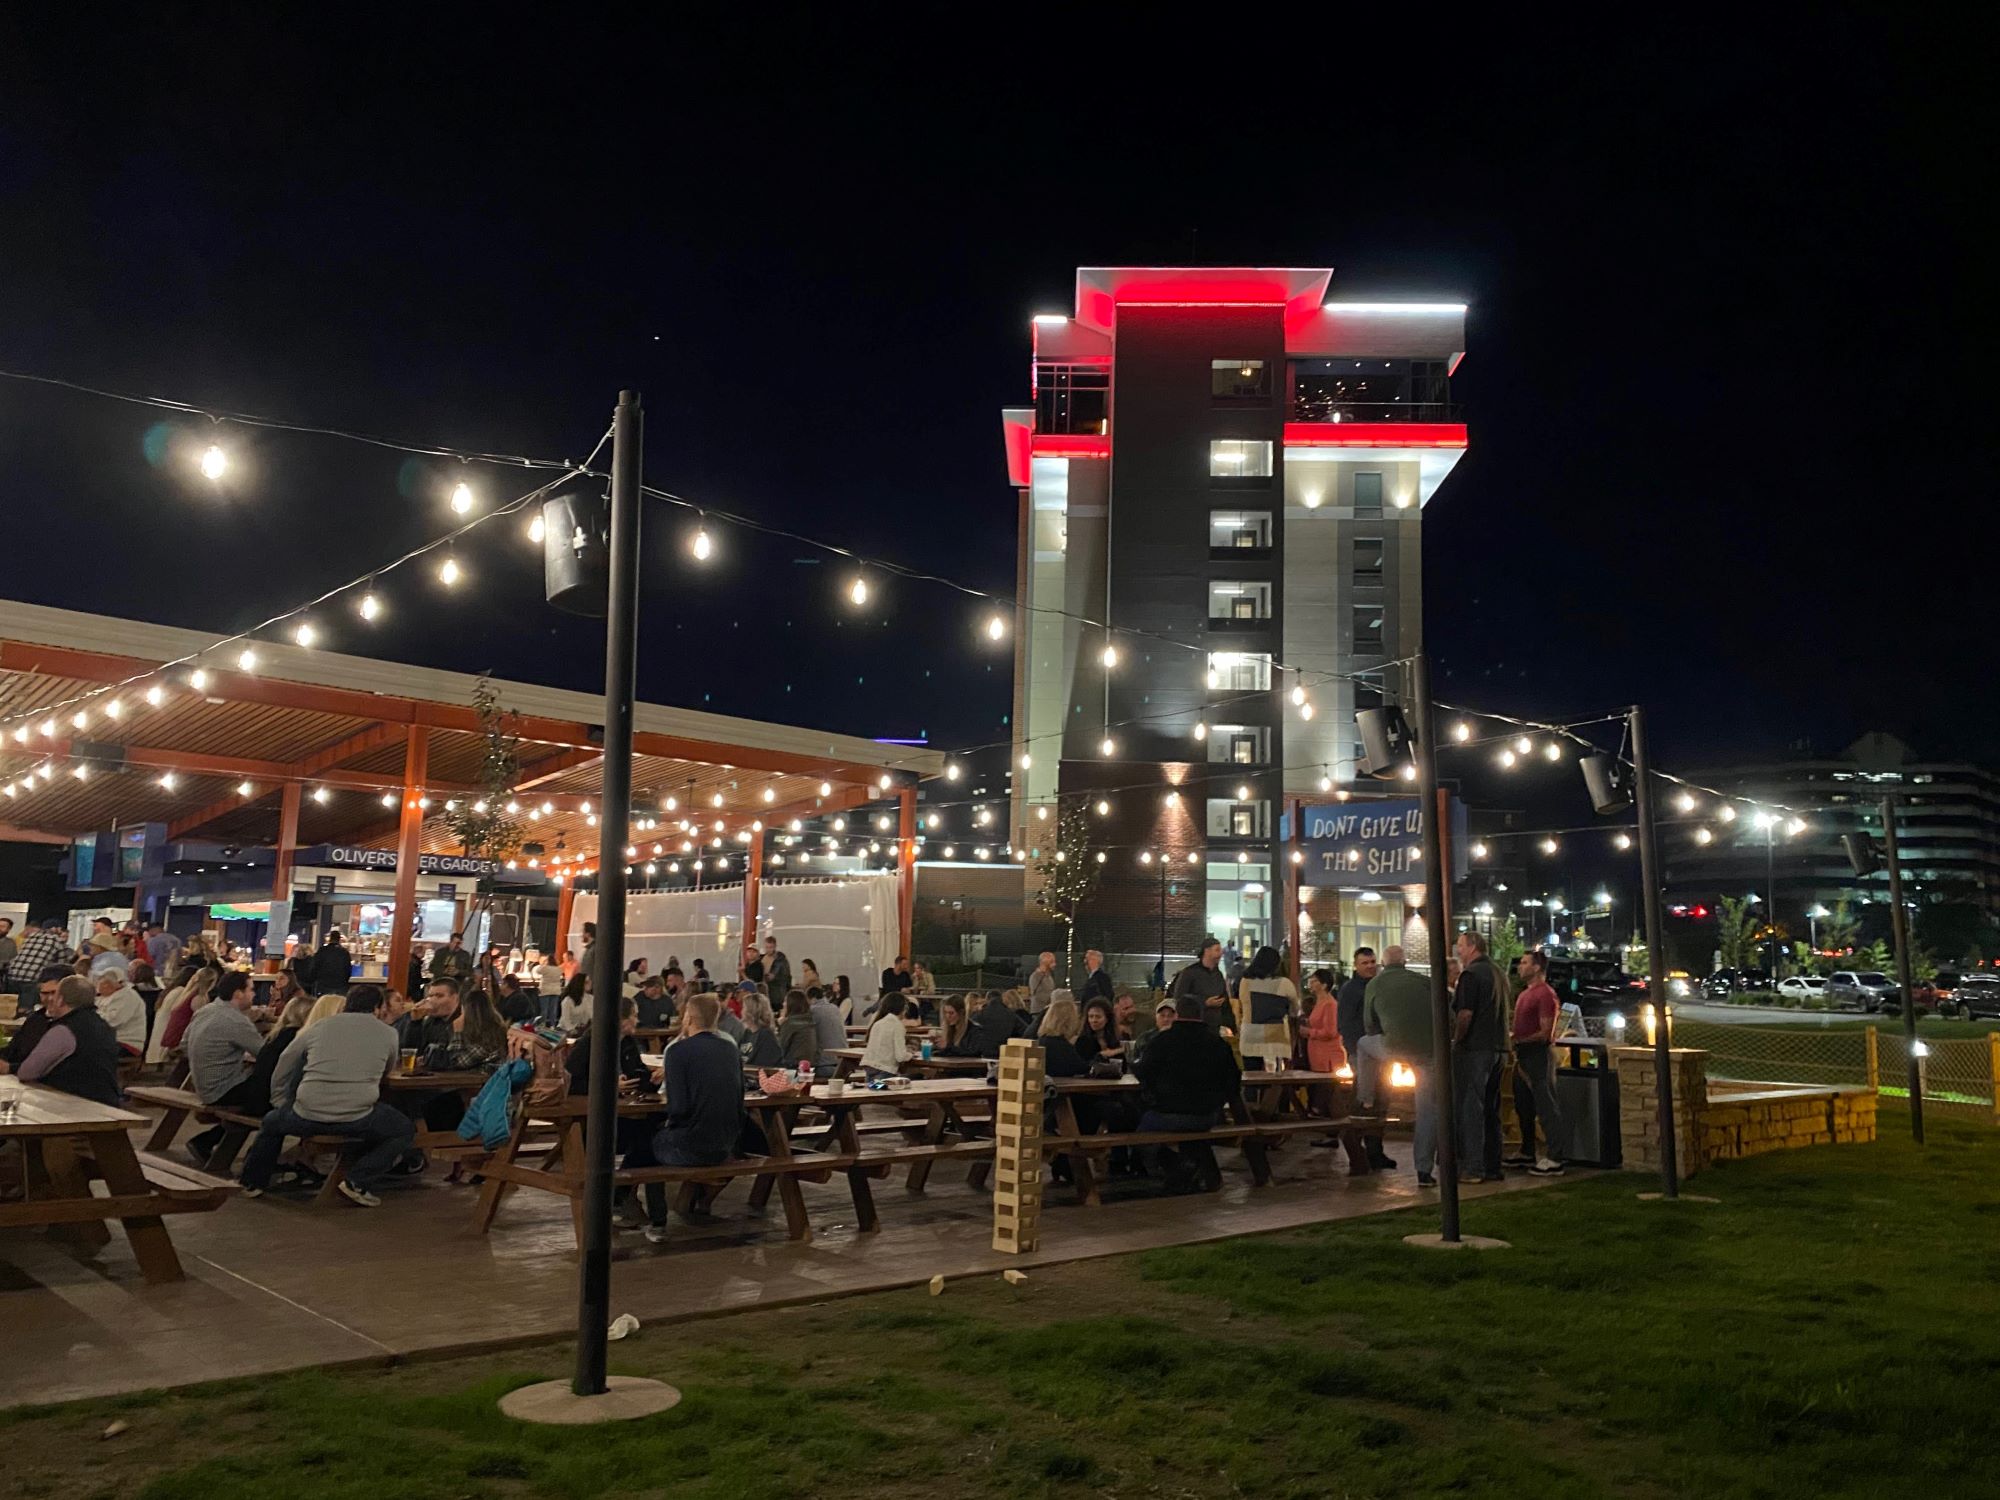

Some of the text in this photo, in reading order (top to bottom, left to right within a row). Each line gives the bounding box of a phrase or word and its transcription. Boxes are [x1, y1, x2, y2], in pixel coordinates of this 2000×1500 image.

[1313, 815, 1358, 840] DONT
[1360, 816, 1402, 839] GIVE
[332, 848, 397, 866] OLIVER'S
